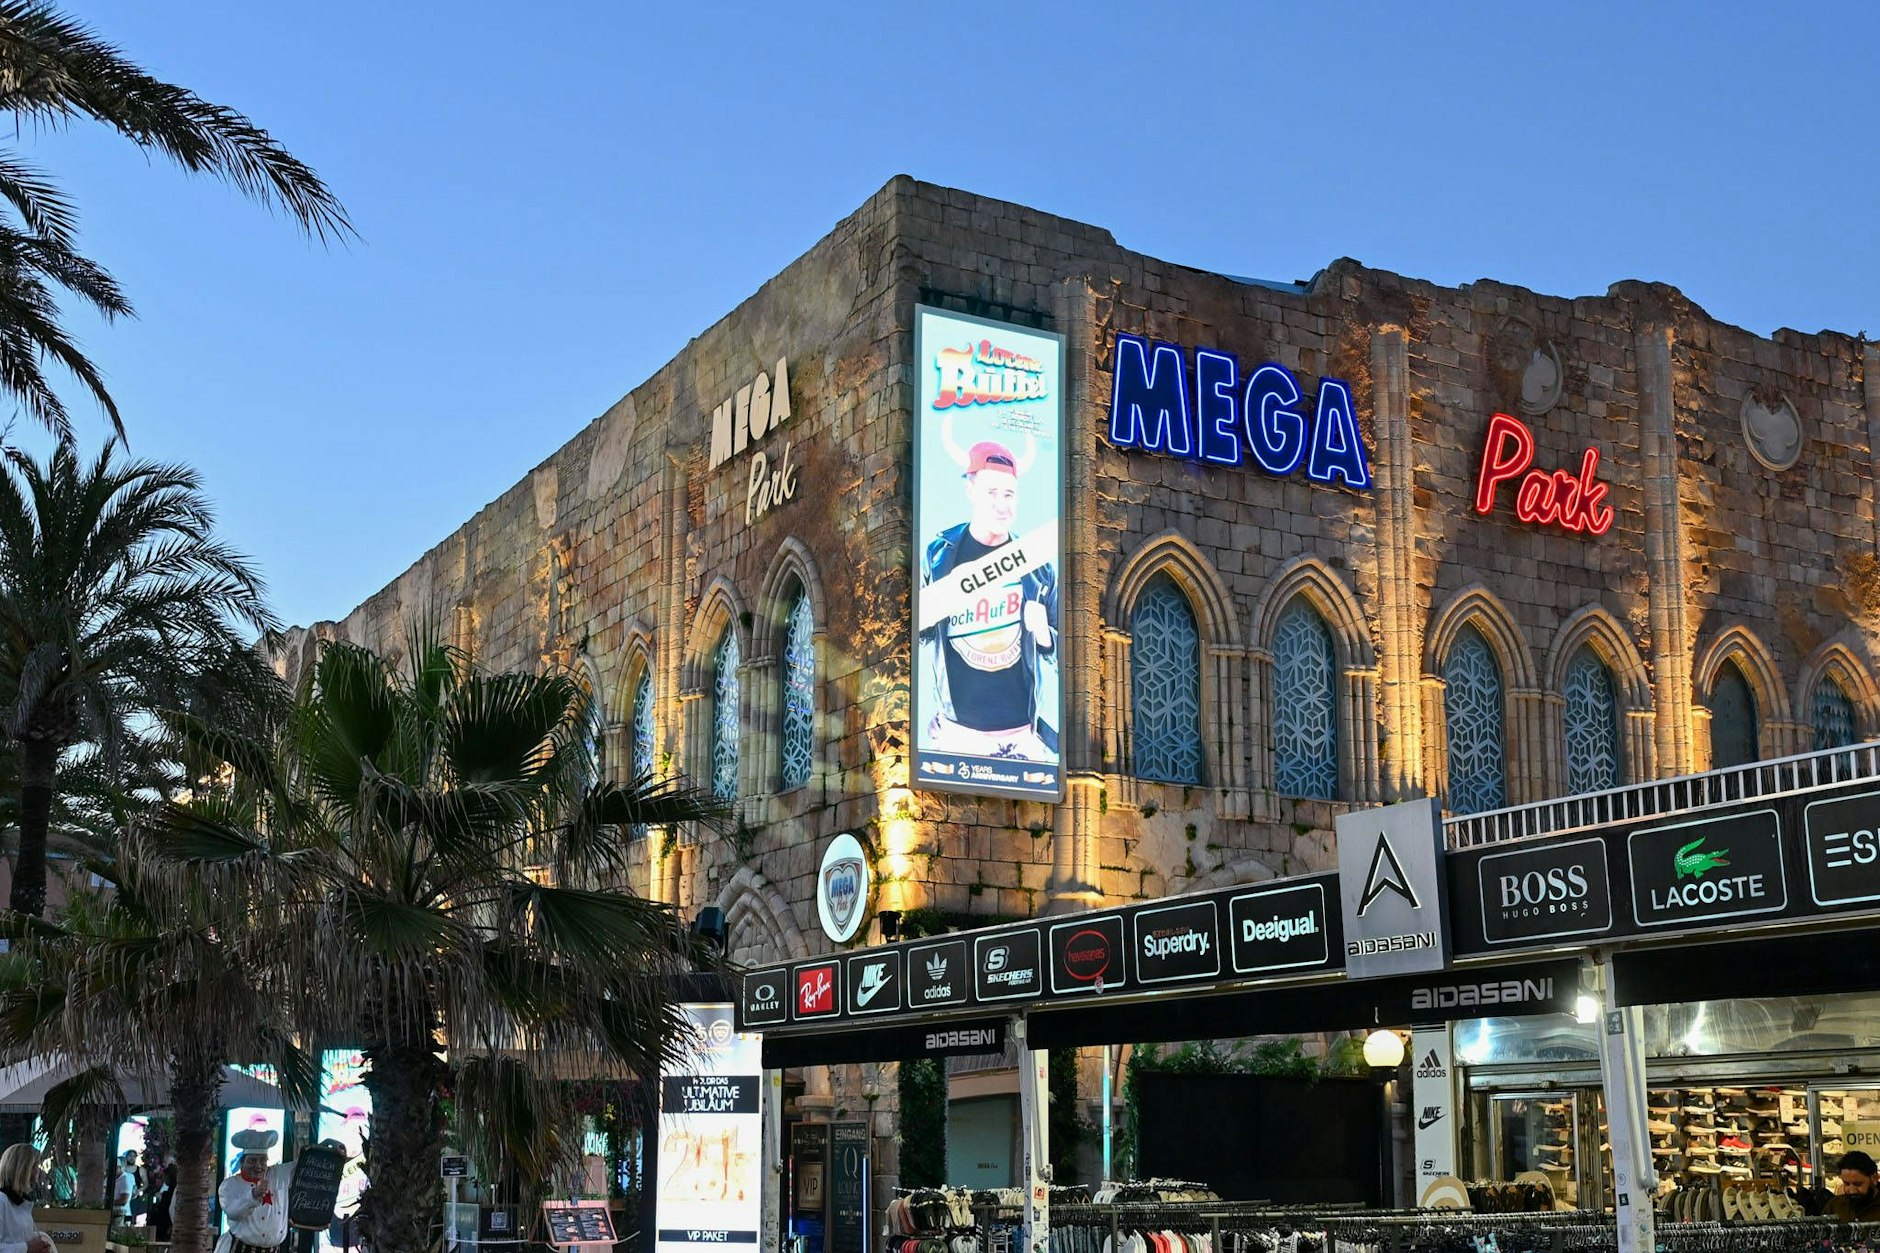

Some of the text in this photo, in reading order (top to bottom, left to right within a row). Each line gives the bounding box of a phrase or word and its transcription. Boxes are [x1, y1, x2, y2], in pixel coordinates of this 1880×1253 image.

[708, 355, 791, 472] MEGA
[1108, 331, 1374, 490] MEGA
[1476, 412, 1614, 535] Park
[745, 441, 797, 526] Park
[960, 549, 1027, 594] GLEICH
[971, 765, 992, 774] YEARS
[971, 773, 1019, 783] ANNIVERSARY
[1824, 827, 1880, 868] ES
[831, 875, 854, 898] MEGA
[1500, 864, 1589, 908] BOSS
[1650, 874, 1766, 912] LACOSTE
[1503, 900, 1589, 920] HUGO BOSS
[861, 962, 888, 988] NIKE
[986, 968, 1033, 984] SKECHERS
[924, 984, 951, 1000] adidas
[750, 1001, 779, 1012] OAKLEY
[1416, 1067, 1447, 1079] adidas
[682, 1086, 740, 1098] ULTIMATIVE
[1422, 1106, 1442, 1118] NIKE
[836, 1128, 866, 1141] EINGANG
[804, 1177, 818, 1196] VIP
[687, 1230, 729, 1242] VIP PAKET
